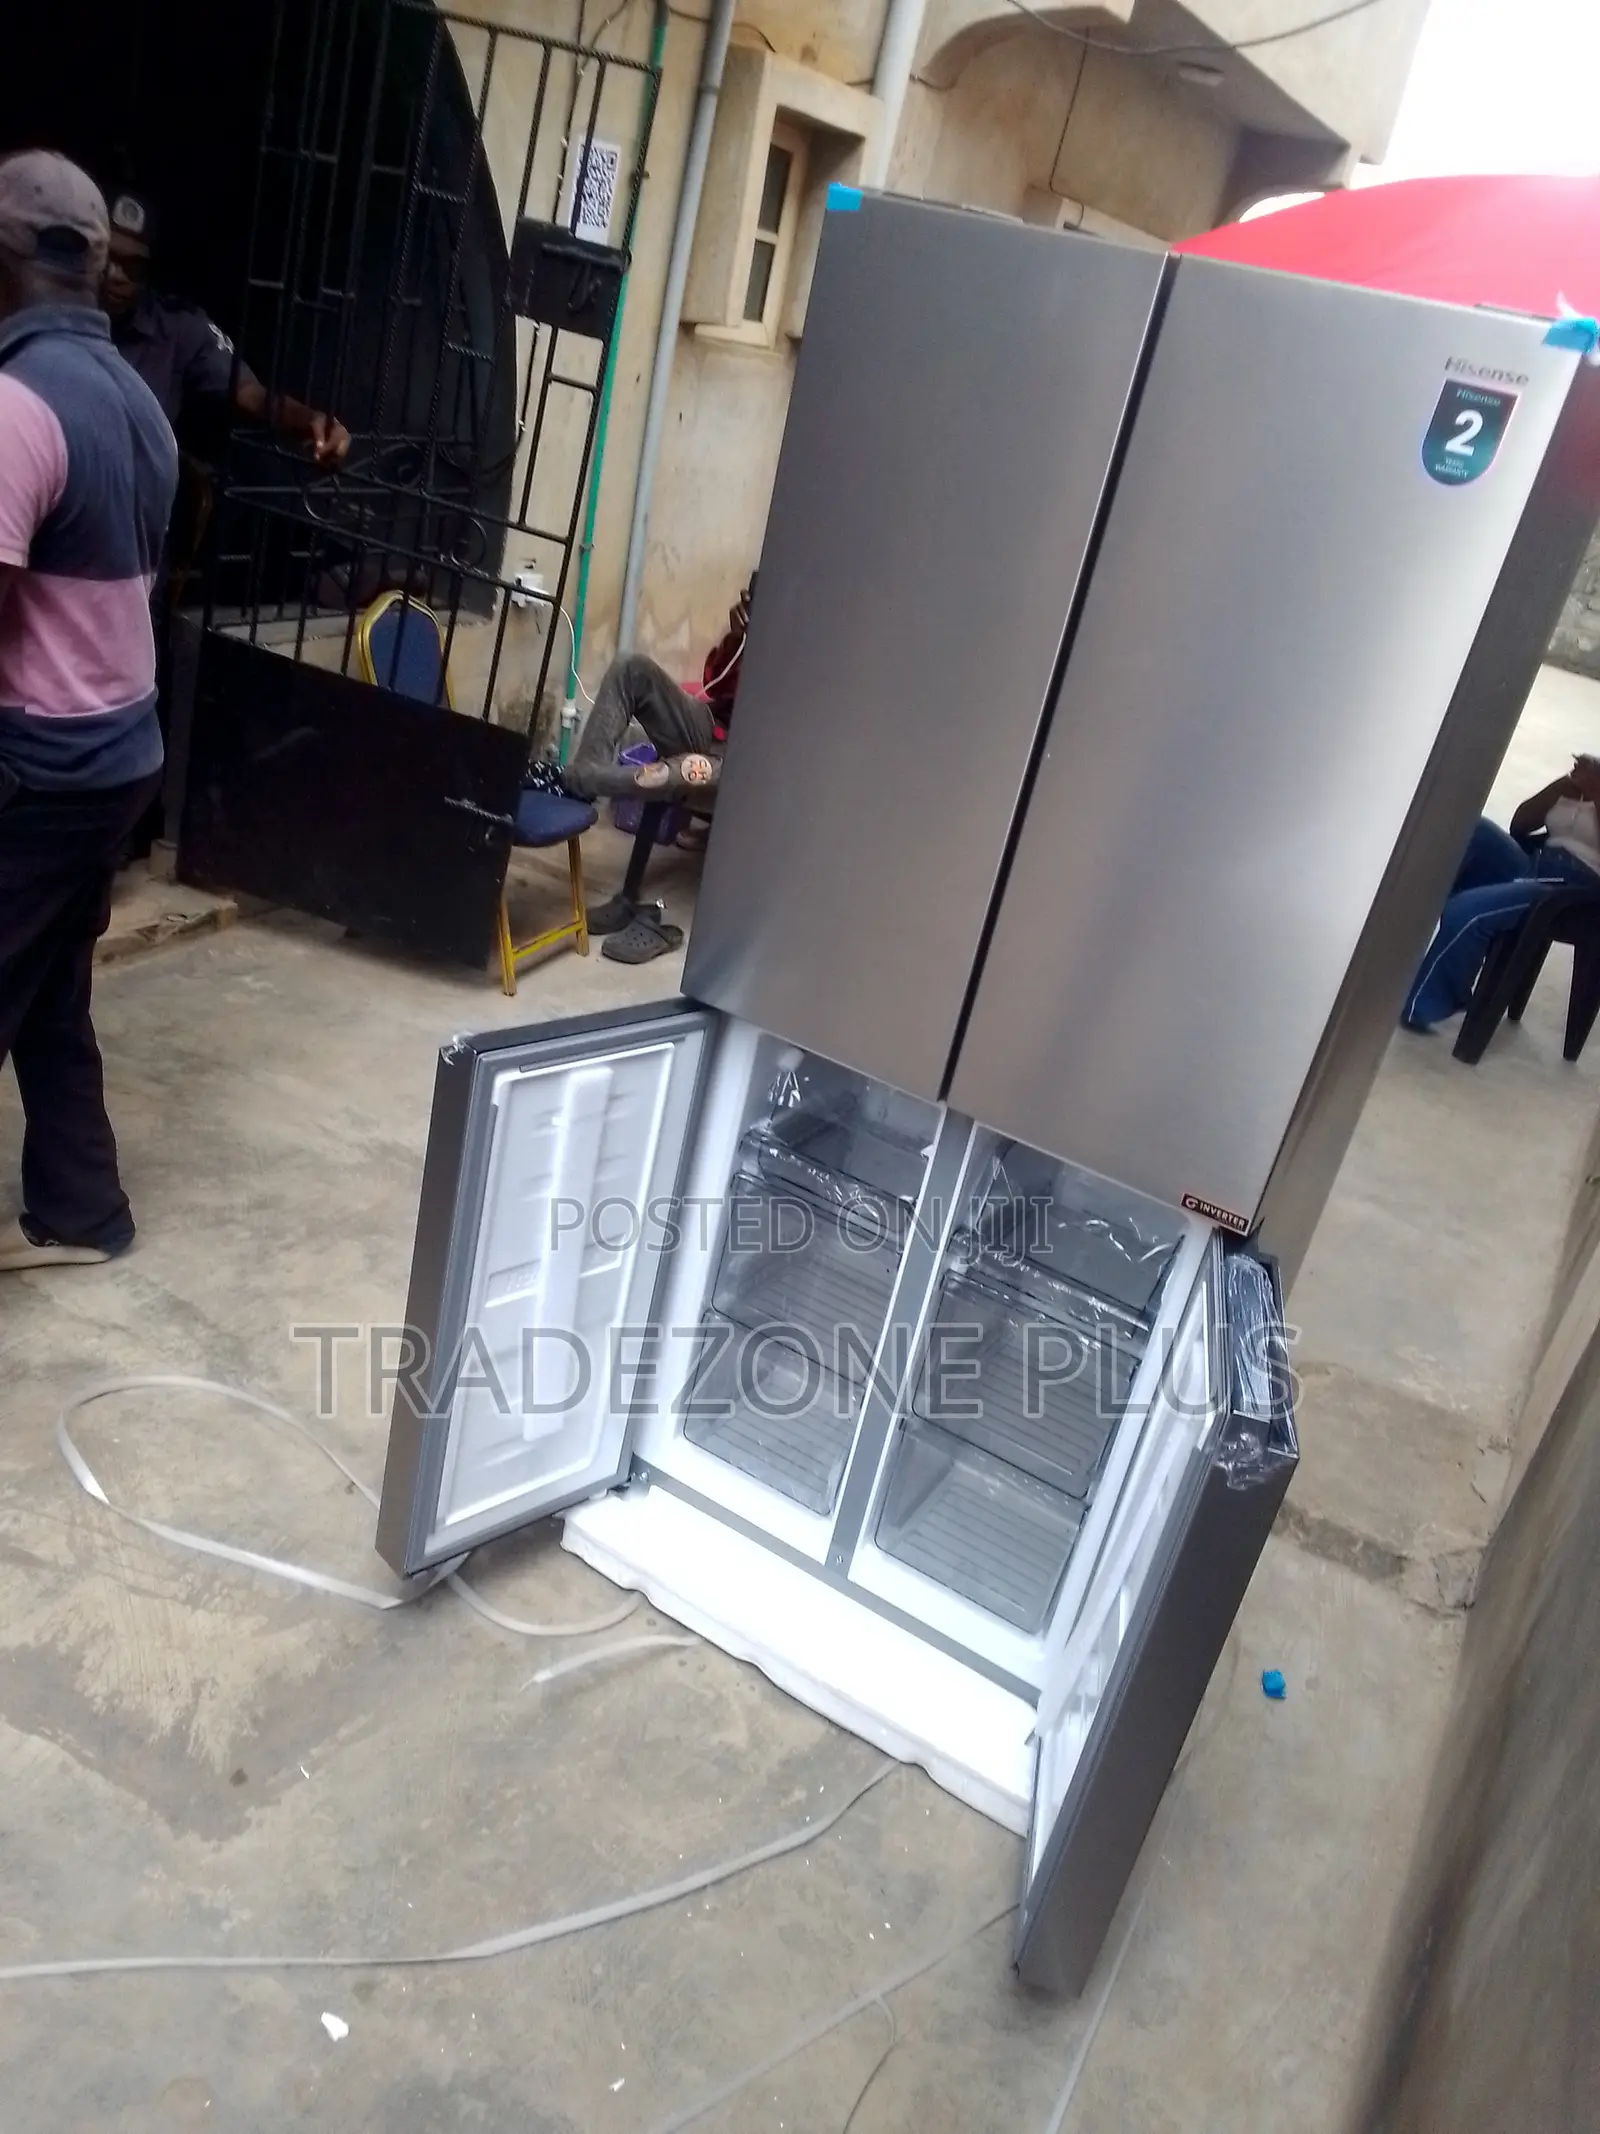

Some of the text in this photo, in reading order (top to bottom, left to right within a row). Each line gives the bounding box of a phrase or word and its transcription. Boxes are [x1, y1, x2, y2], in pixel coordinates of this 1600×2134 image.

[1444, 356, 1529, 387] Hisense
[1456, 387, 1501, 407] Hisense
[1444, 409, 1483, 456] 2
[1200, 1202, 1245, 1230] INVERTER
